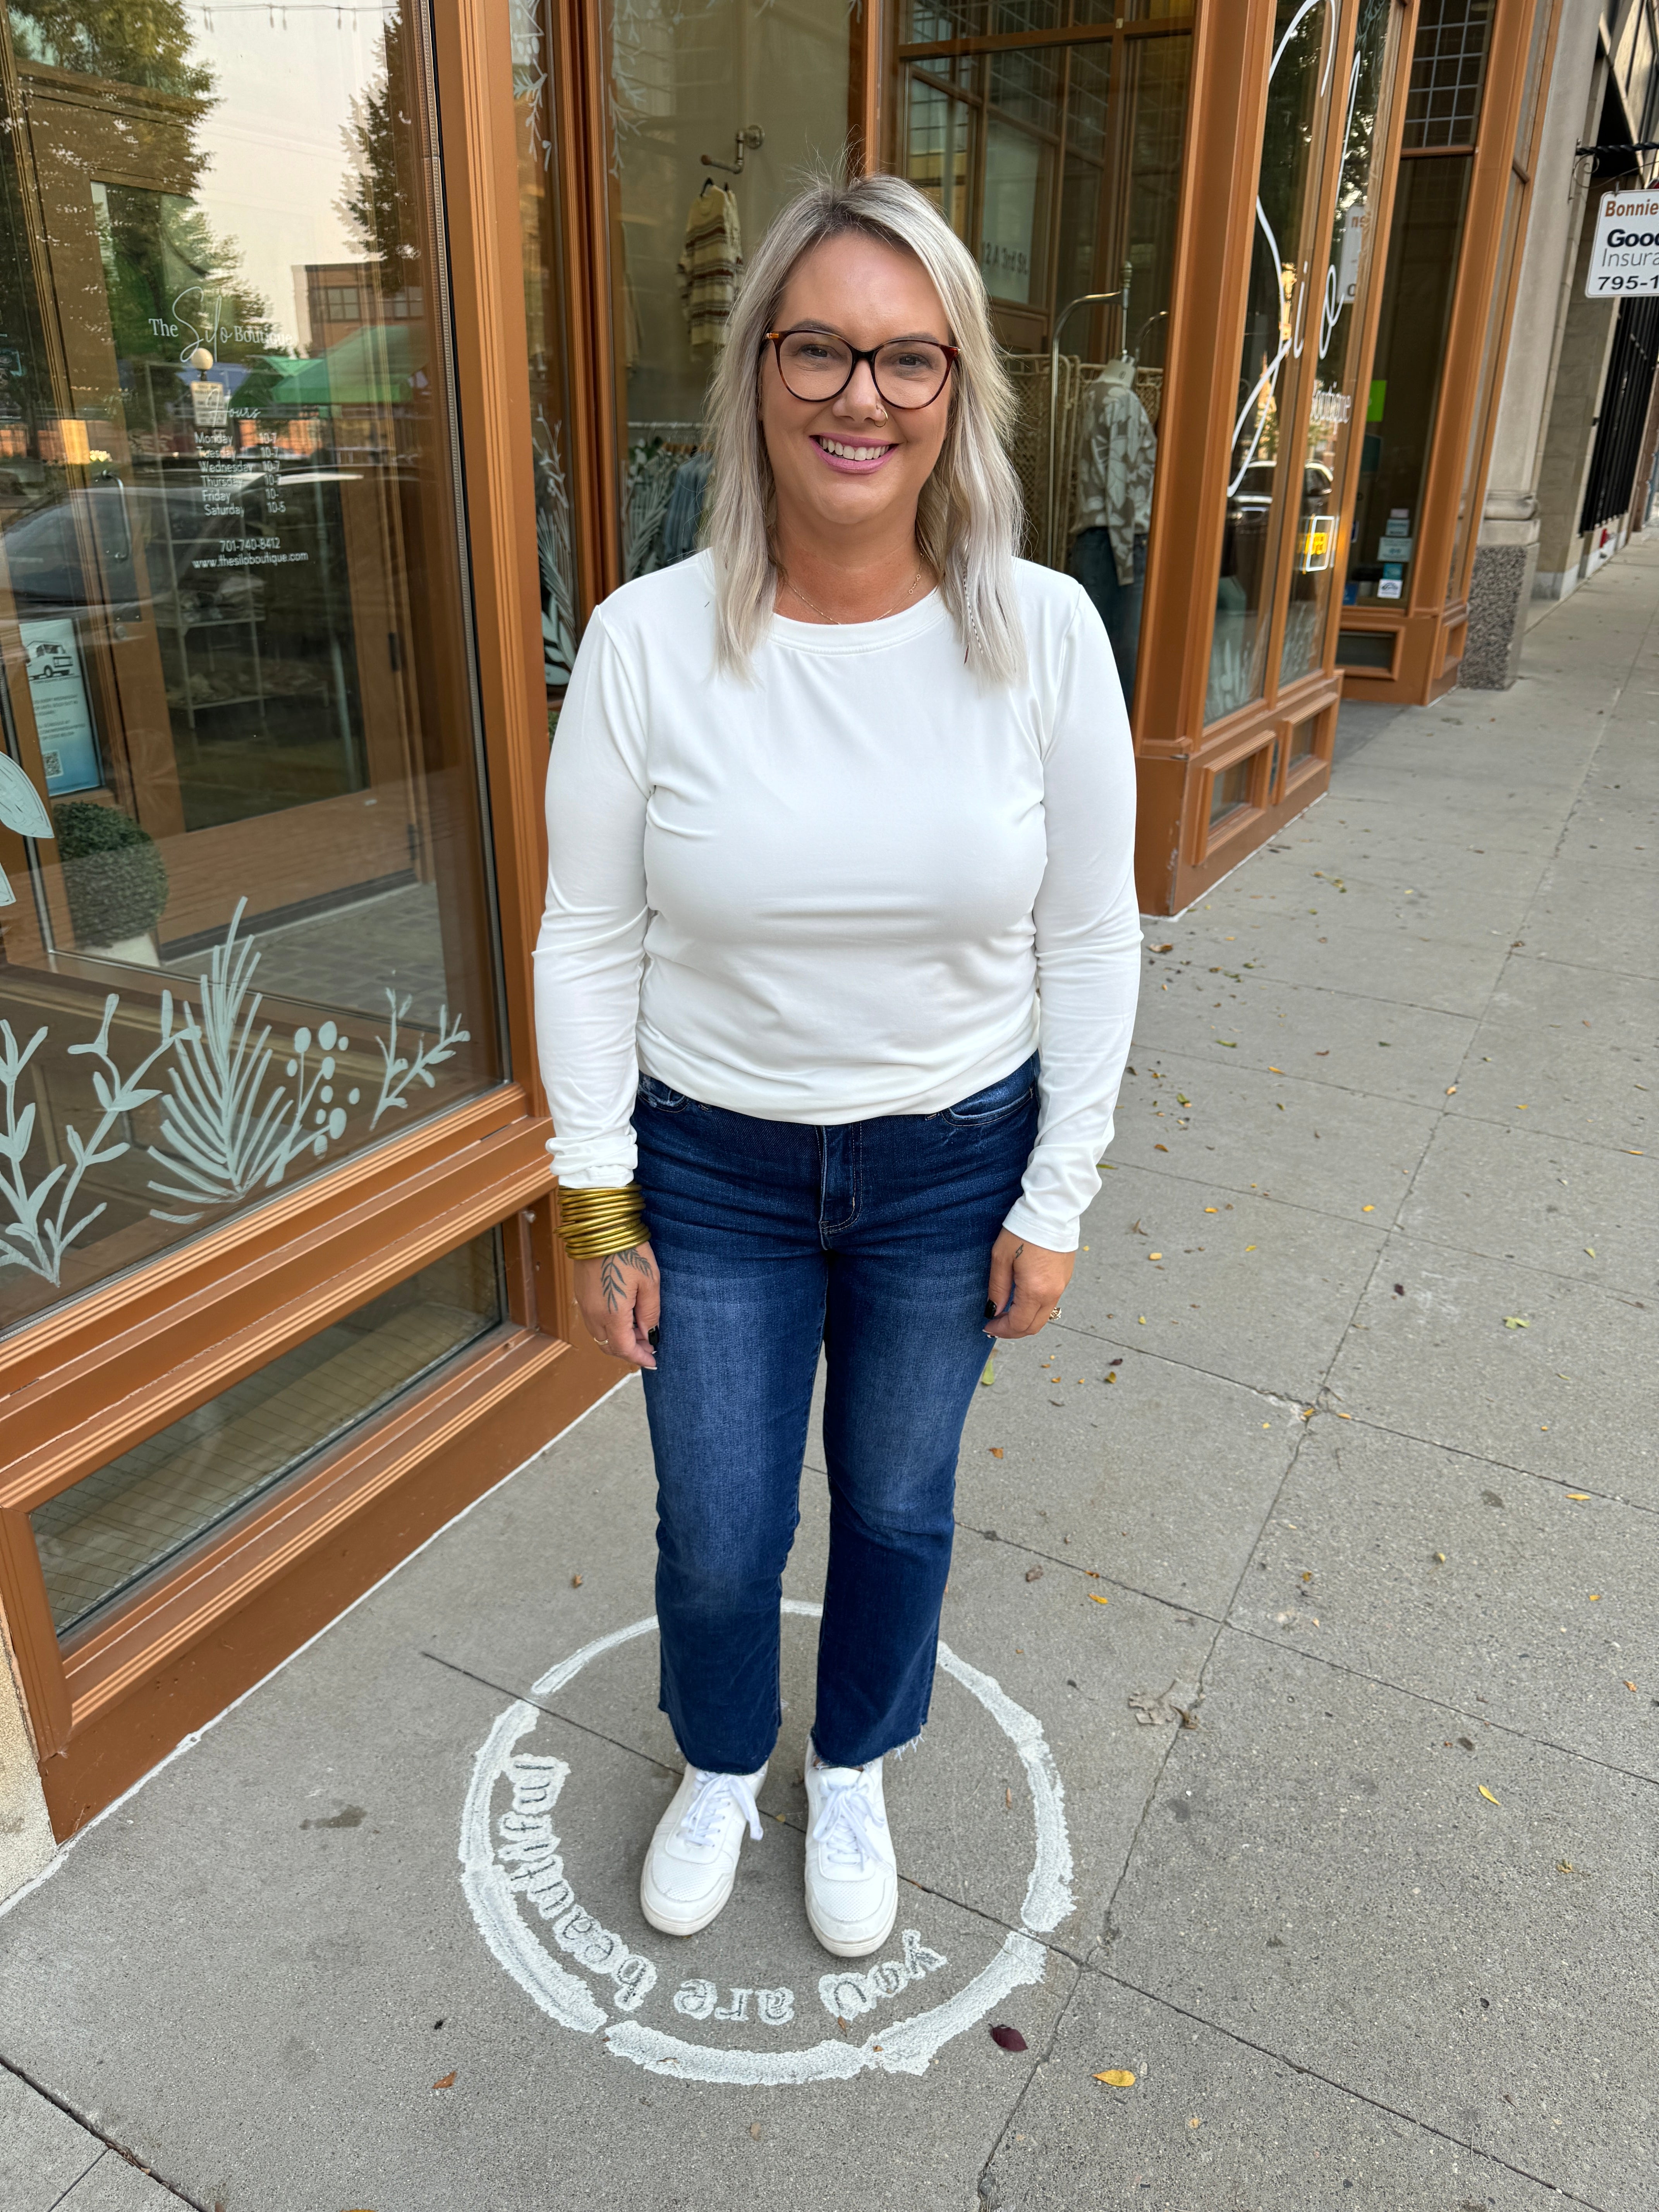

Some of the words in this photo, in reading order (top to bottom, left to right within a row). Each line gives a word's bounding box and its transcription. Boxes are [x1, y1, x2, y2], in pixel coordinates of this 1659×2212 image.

[1605, 198, 1659, 217] Bonnie
[148, 318, 179, 337] The
[172, 286, 232, 363] Silo
[234, 325, 293, 345] Boutique
[205, 388, 261, 427] Hours
[194, 431, 232, 445] Monday
[196, 446, 236, 461] Tuesday
[260, 446, 278, 458] 10-7
[198, 460, 253, 472] Wednesday
[262, 460, 280, 472] 10-7
[199, 475, 243, 489] Thursday
[264, 474, 282, 486] 10-7
[202, 489, 231, 503] Friday
[204, 503, 245, 517] Saturday
[267, 501, 286, 513] 10-5
[220, 537, 281, 552] 701-740-8412
[192, 552, 309, 568] www.thesiloboutique.com
[498, 1753, 658, 2011] beautiful
[673, 1978, 795, 2025] are
